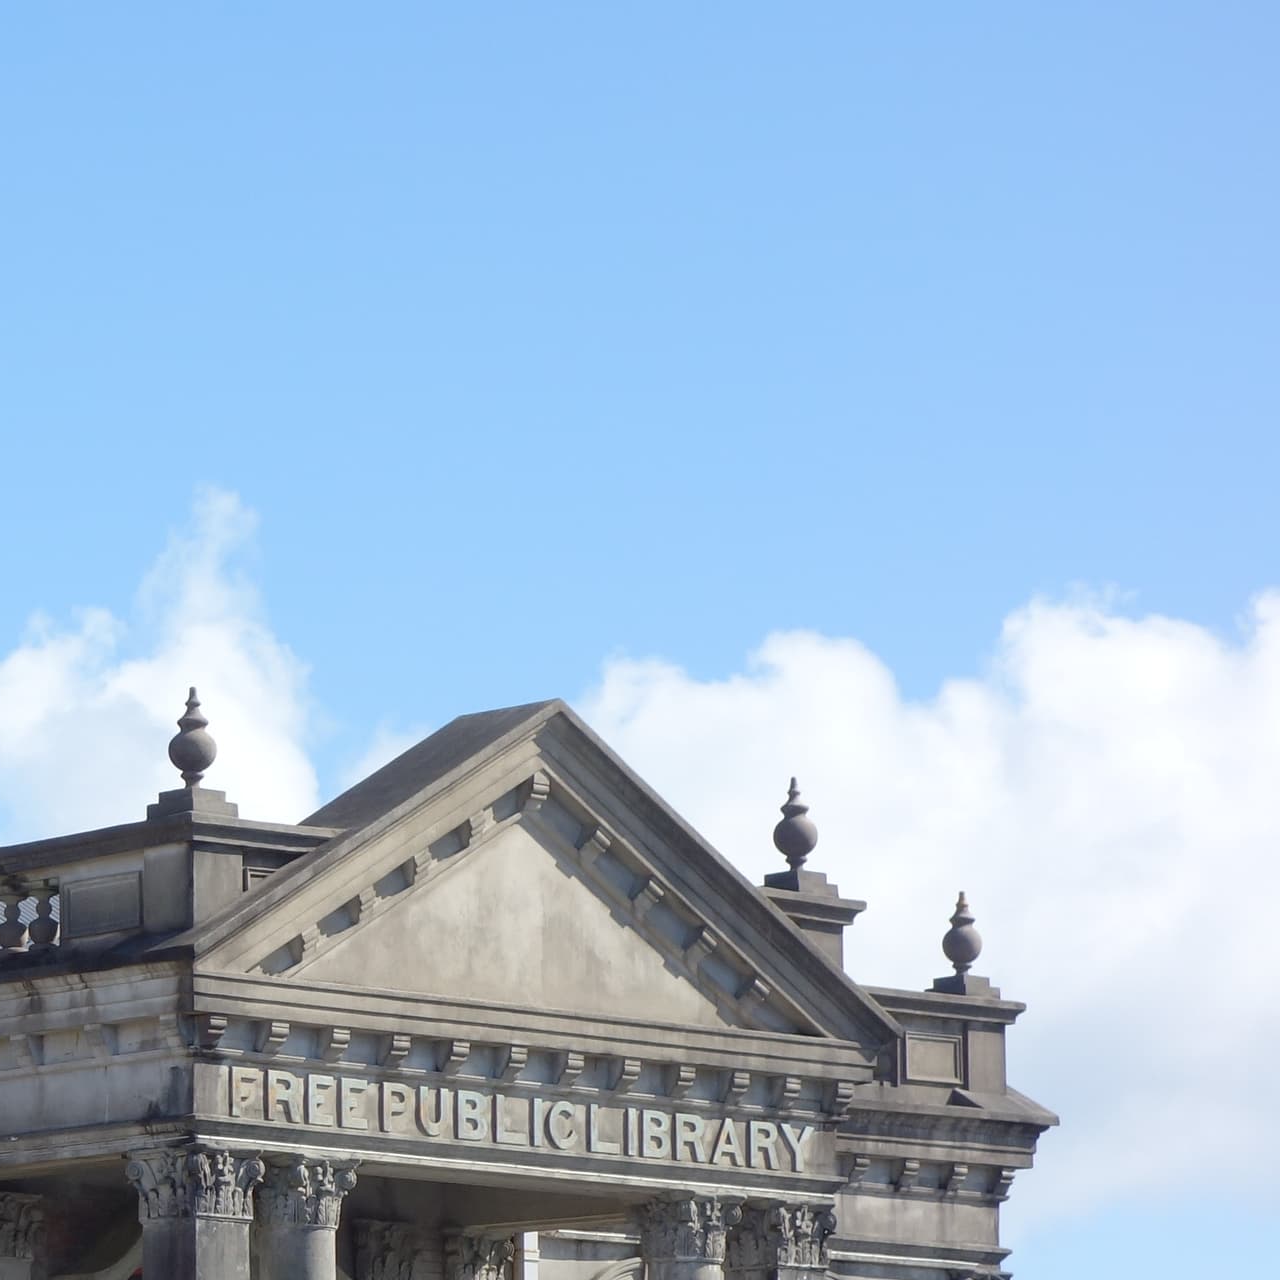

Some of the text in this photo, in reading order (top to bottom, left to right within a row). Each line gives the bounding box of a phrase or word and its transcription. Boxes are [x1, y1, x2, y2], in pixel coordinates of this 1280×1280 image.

[229, 1065, 815, 1173] FREE PUBLIC LIBRARY
